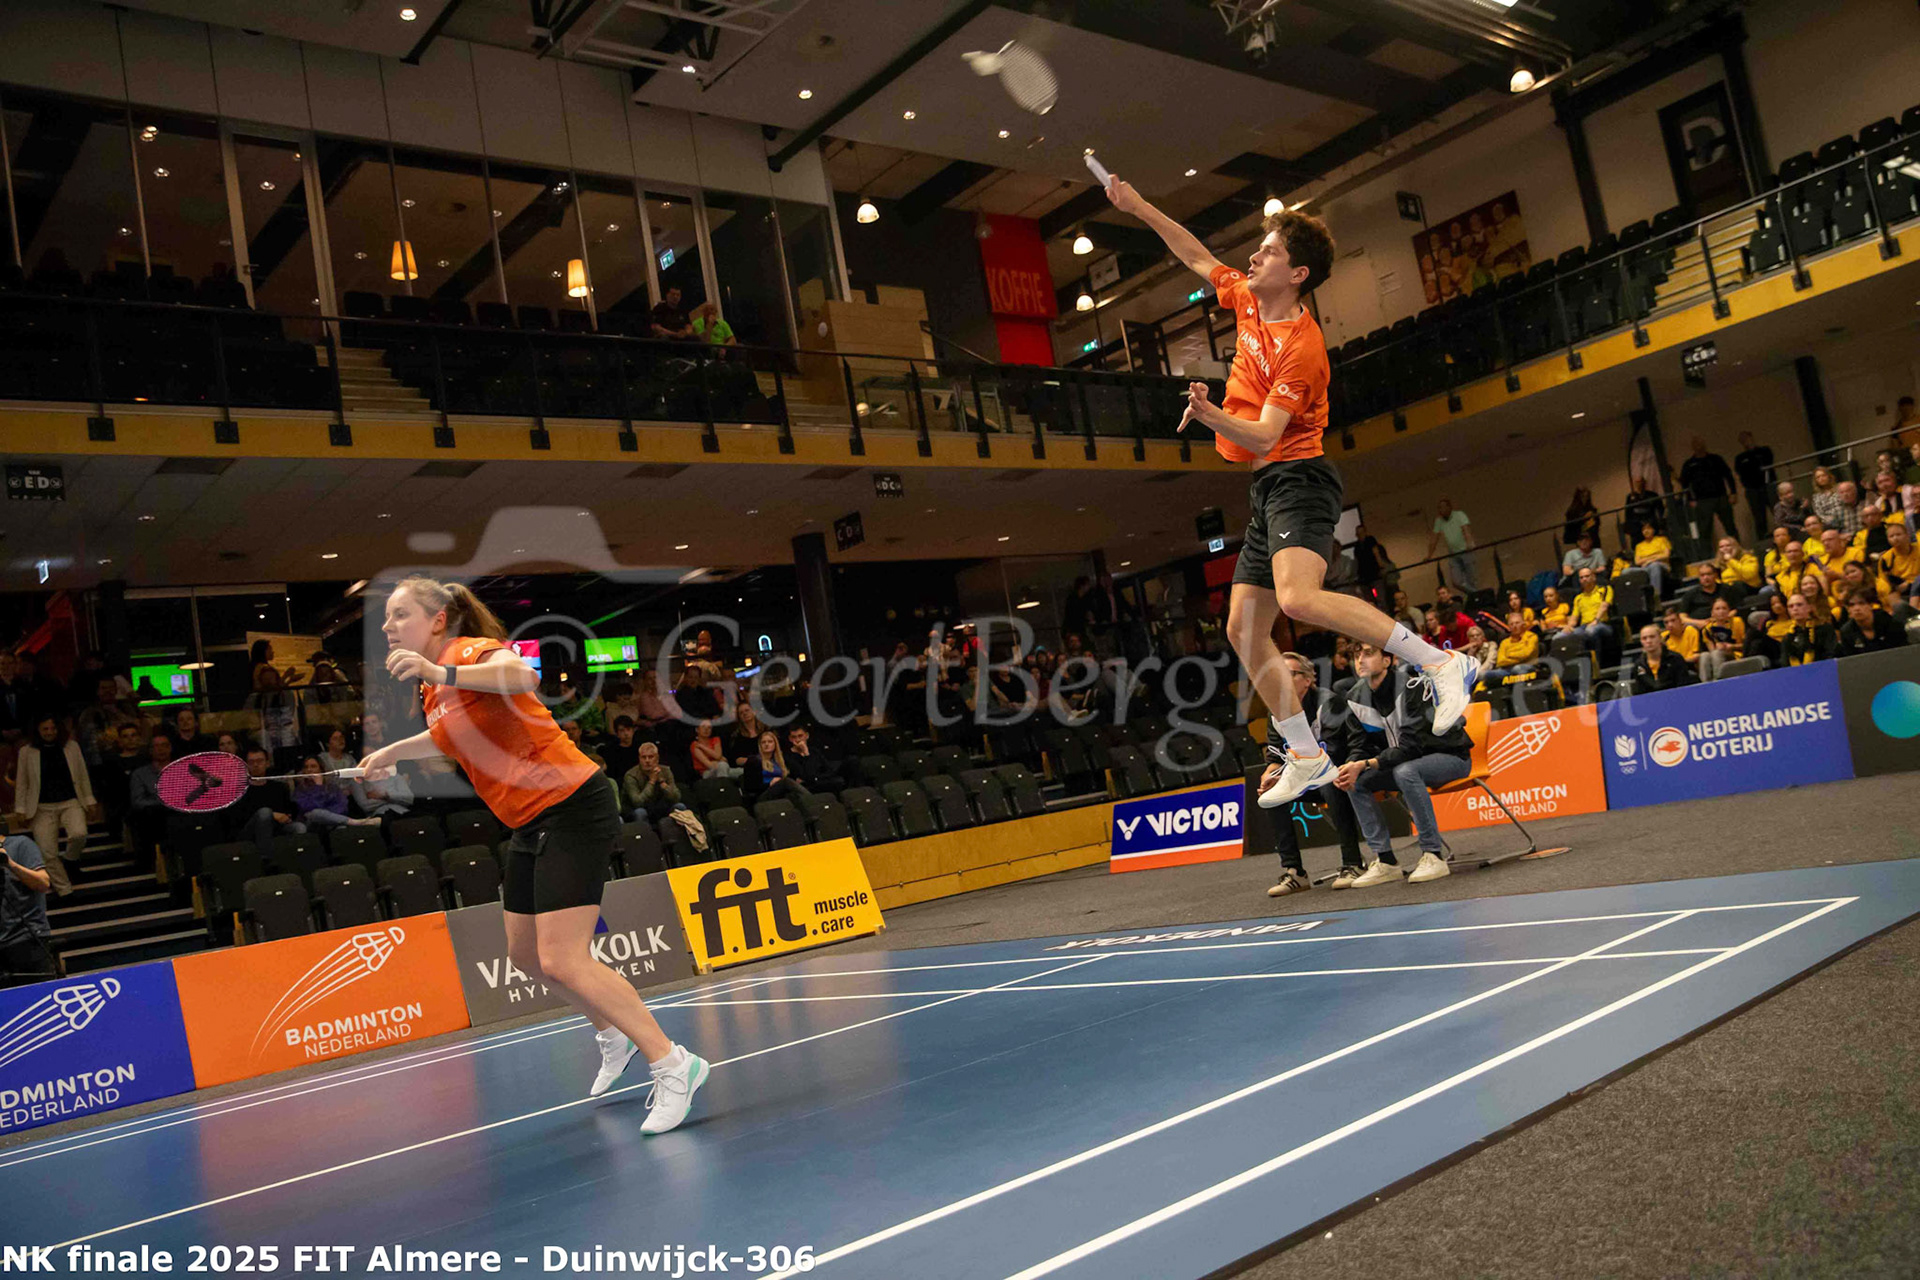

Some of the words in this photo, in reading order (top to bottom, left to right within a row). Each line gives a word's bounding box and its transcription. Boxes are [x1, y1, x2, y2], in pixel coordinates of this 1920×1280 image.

[985, 266, 1047, 314] KOFFIE
[37, 476, 50, 489] D
[1688, 702, 1832, 741] NEDERLANDSE
[1691, 733, 1773, 762] LOTERIJ
[1145, 801, 1239, 837] VICTOR
[814, 890, 869, 915] muscle
[285, 1002, 423, 1046] BADMINTON
[304, 1023, 412, 1058] NEDERLAND
